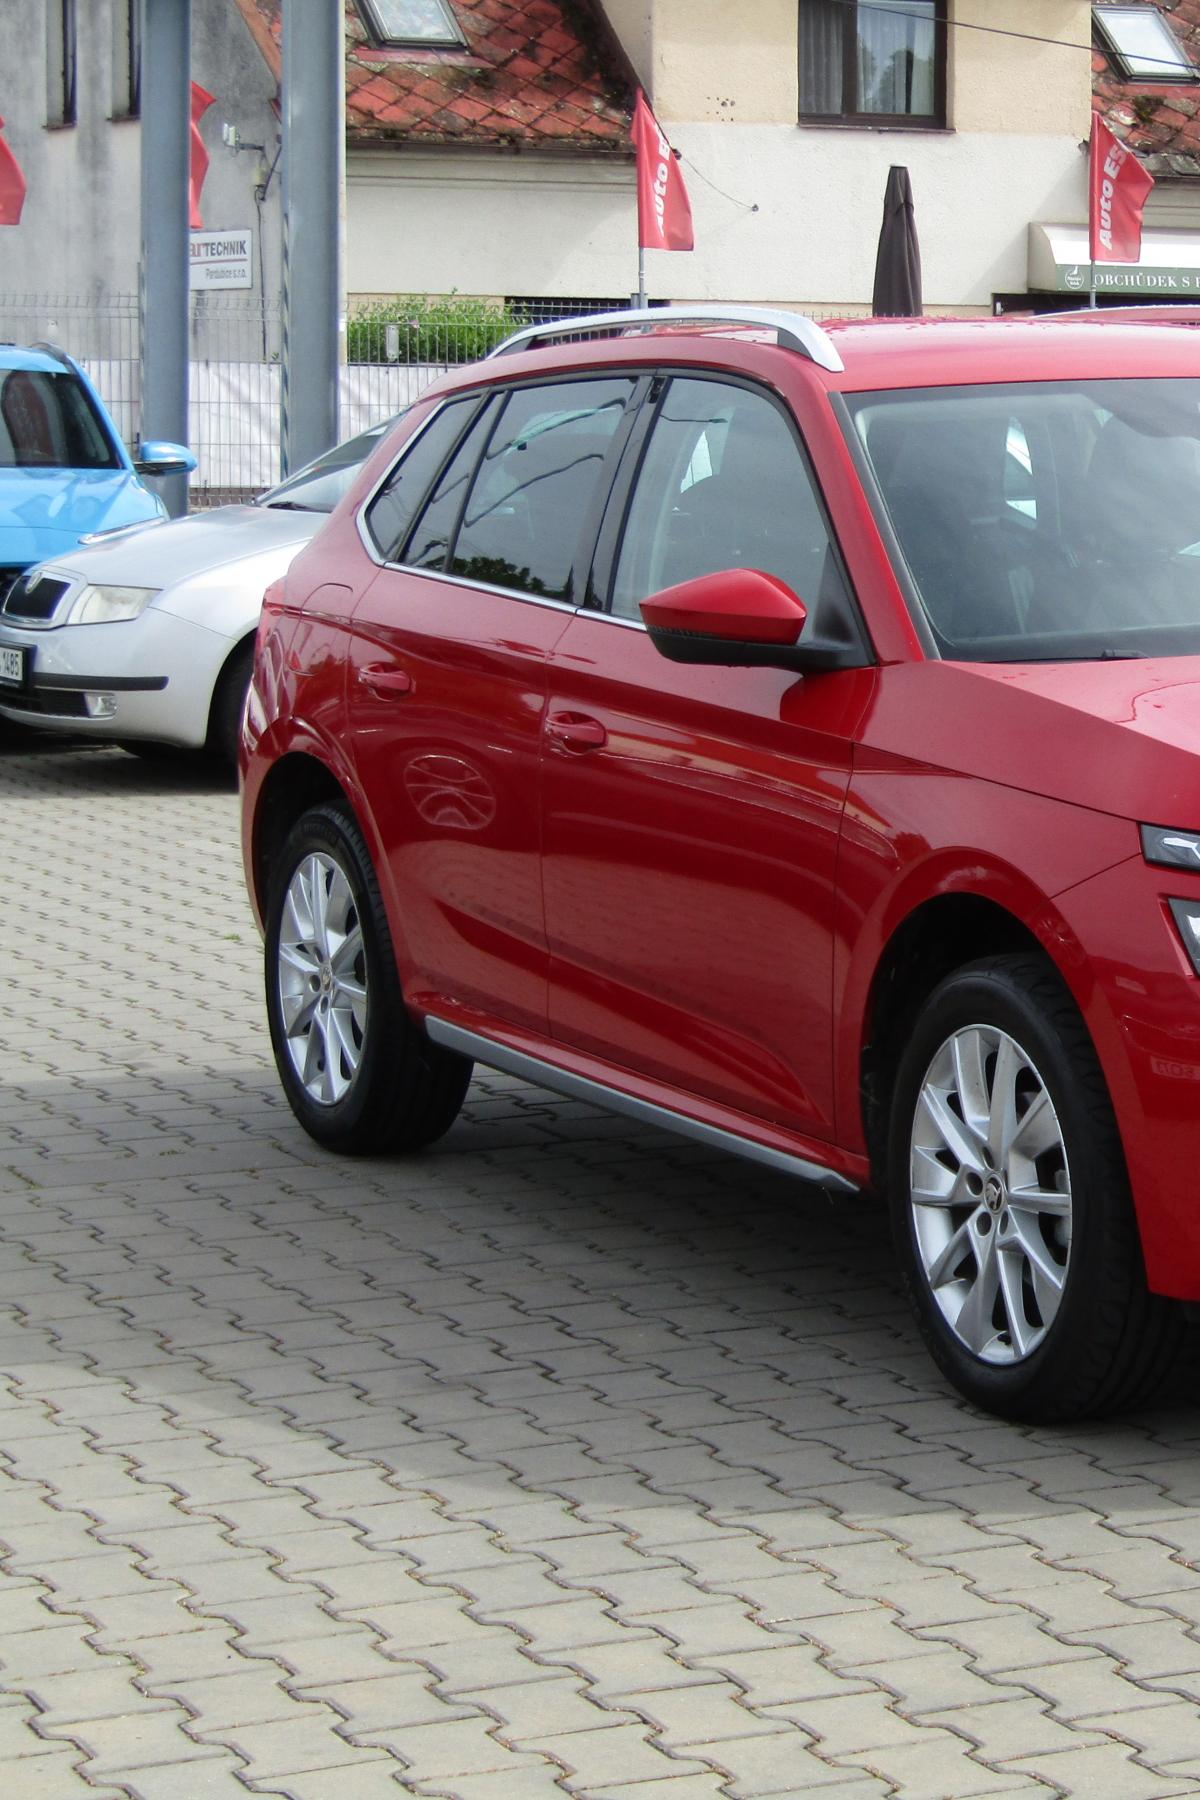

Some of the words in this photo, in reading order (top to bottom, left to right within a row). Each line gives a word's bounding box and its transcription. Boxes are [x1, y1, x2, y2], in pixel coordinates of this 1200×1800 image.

[1104, 143, 1128, 180] ES
[1099, 179, 1115, 251] Auto
[1094, 272, 1178, 288] OBCHŮDEK
[1181, 276, 1191, 288] S
